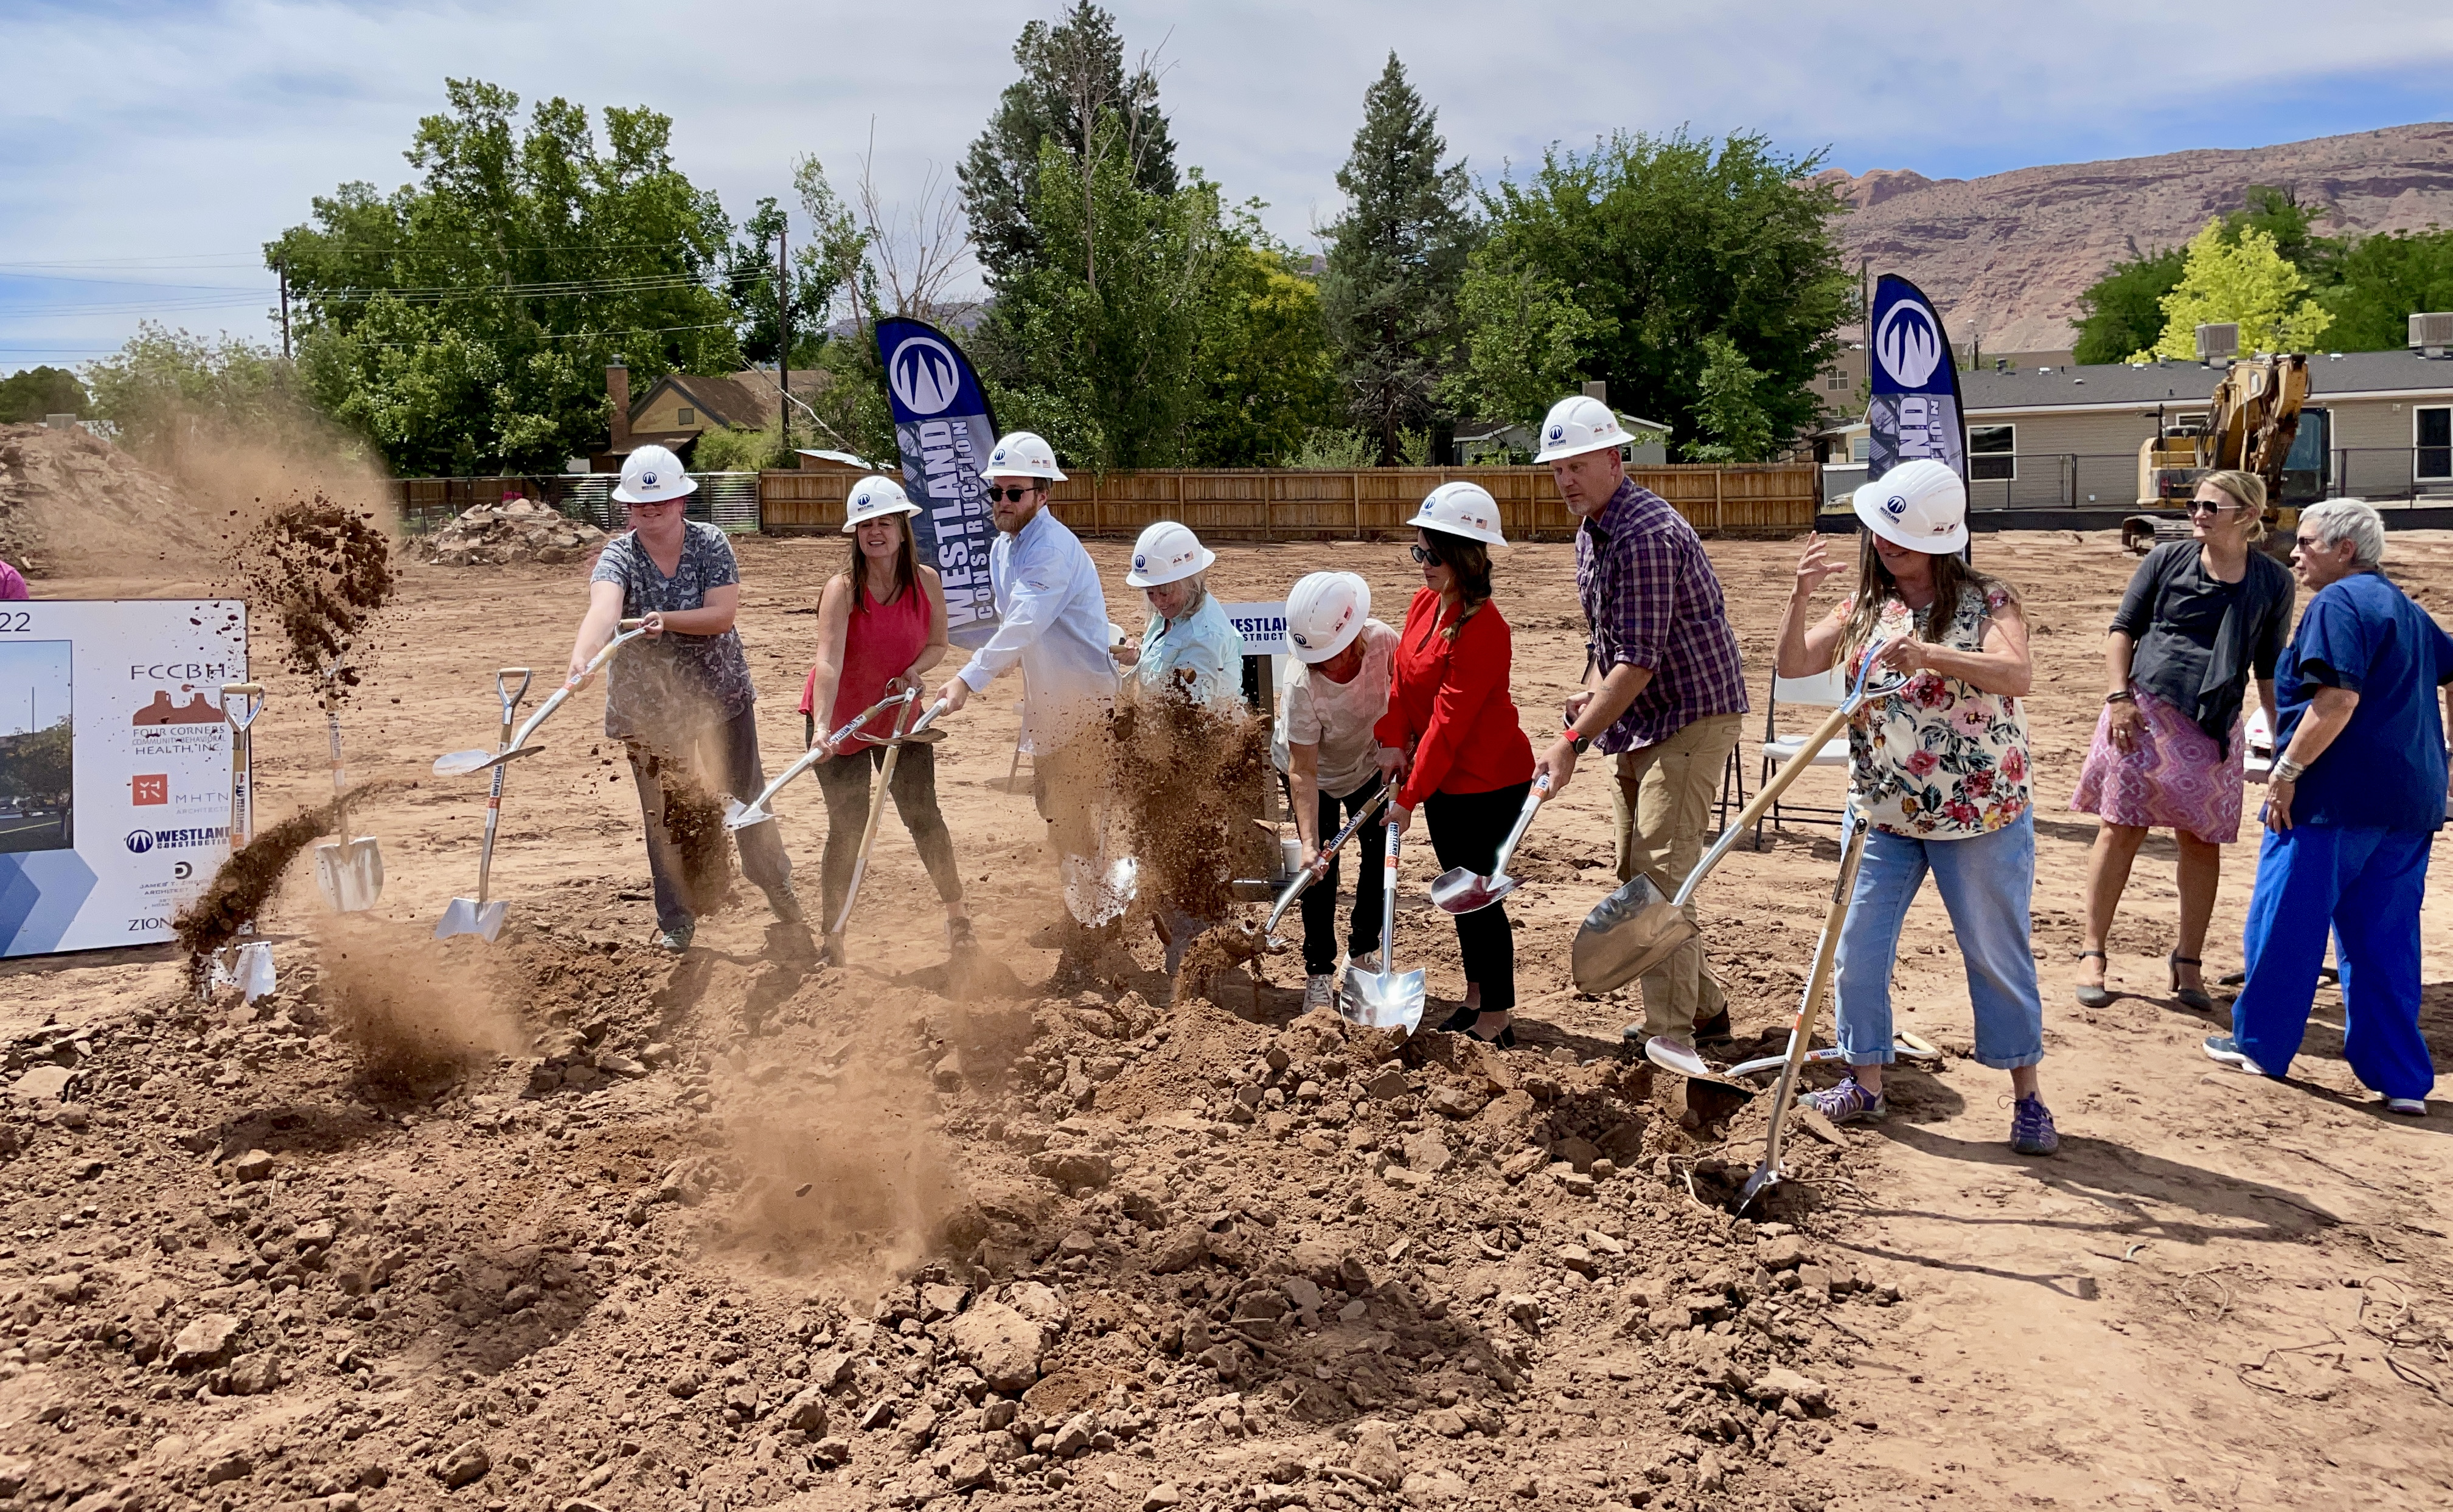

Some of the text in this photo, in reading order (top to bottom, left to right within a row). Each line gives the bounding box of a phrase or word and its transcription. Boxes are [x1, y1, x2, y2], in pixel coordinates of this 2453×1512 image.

[919, 421, 977, 629] WESTLAND
[952, 421, 993, 619] CONSTRUCTION
[1243, 633, 1287, 642] STRUCT
[131, 664, 225, 680] FCCBH
[133, 726, 225, 738] FOUR CORNERS
[176, 792, 229, 804] MHTN
[157, 838, 231, 849] CONSTRUCTIO
